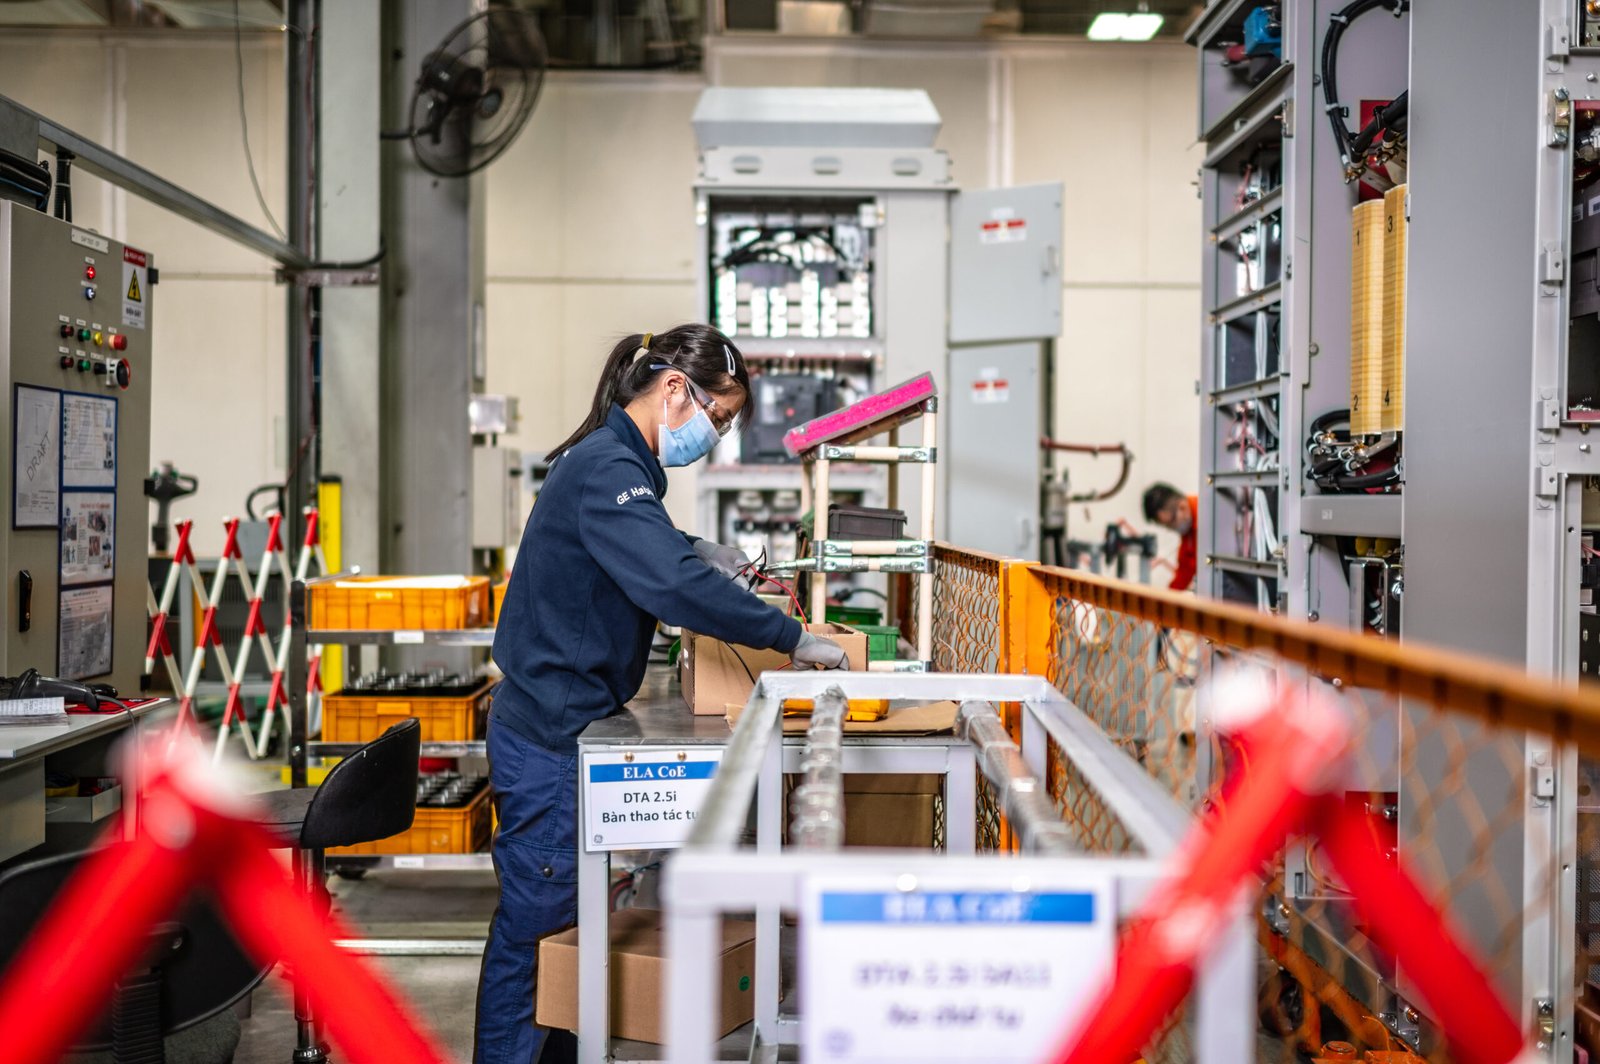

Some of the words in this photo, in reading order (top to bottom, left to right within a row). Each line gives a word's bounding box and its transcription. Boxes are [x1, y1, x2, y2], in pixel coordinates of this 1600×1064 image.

[1387, 215, 1394, 233] 3
[1356, 229, 1360, 246] 1
[1353, 394, 1359, 411] 2
[1384, 388, 1391, 406] 4
[26, 431, 50, 482] DRAFT
[617, 491, 631, 505] GE
[623, 766, 654, 779] ELA
[657, 765, 687, 778] CoE
[623, 792, 650, 804] DTA
[653, 790, 678, 803] 2.5i
[602, 810, 626, 823] Bàn
[630, 809, 659, 822] thao
[663, 808, 682, 820] tác
